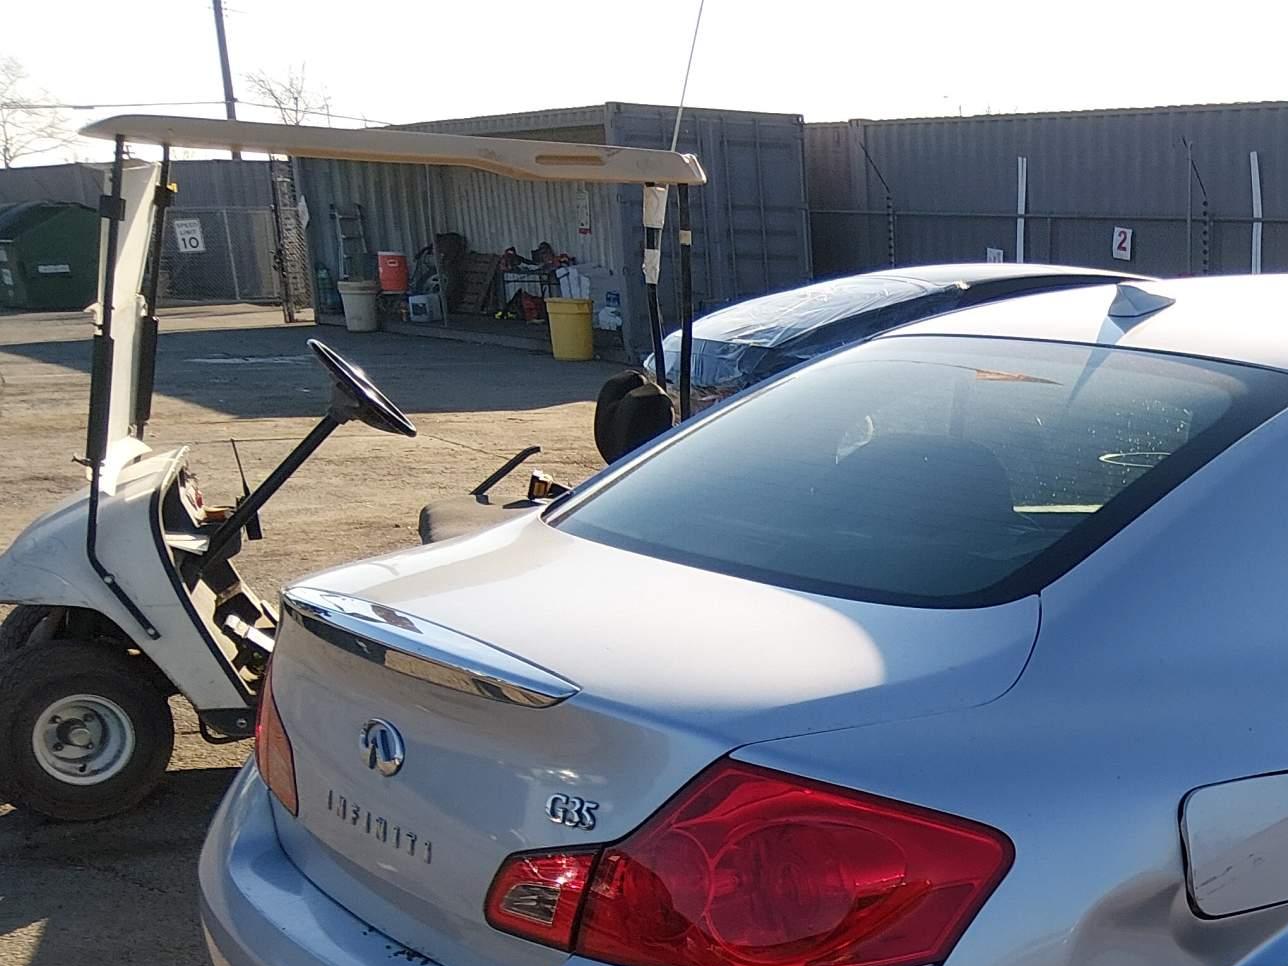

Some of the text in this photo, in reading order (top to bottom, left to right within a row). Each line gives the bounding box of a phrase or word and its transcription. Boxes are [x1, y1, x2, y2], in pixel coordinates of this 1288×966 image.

[181, 236, 200, 249] 10
[1117, 230, 1128, 252] 2
[545, 792, 600, 831] G35
